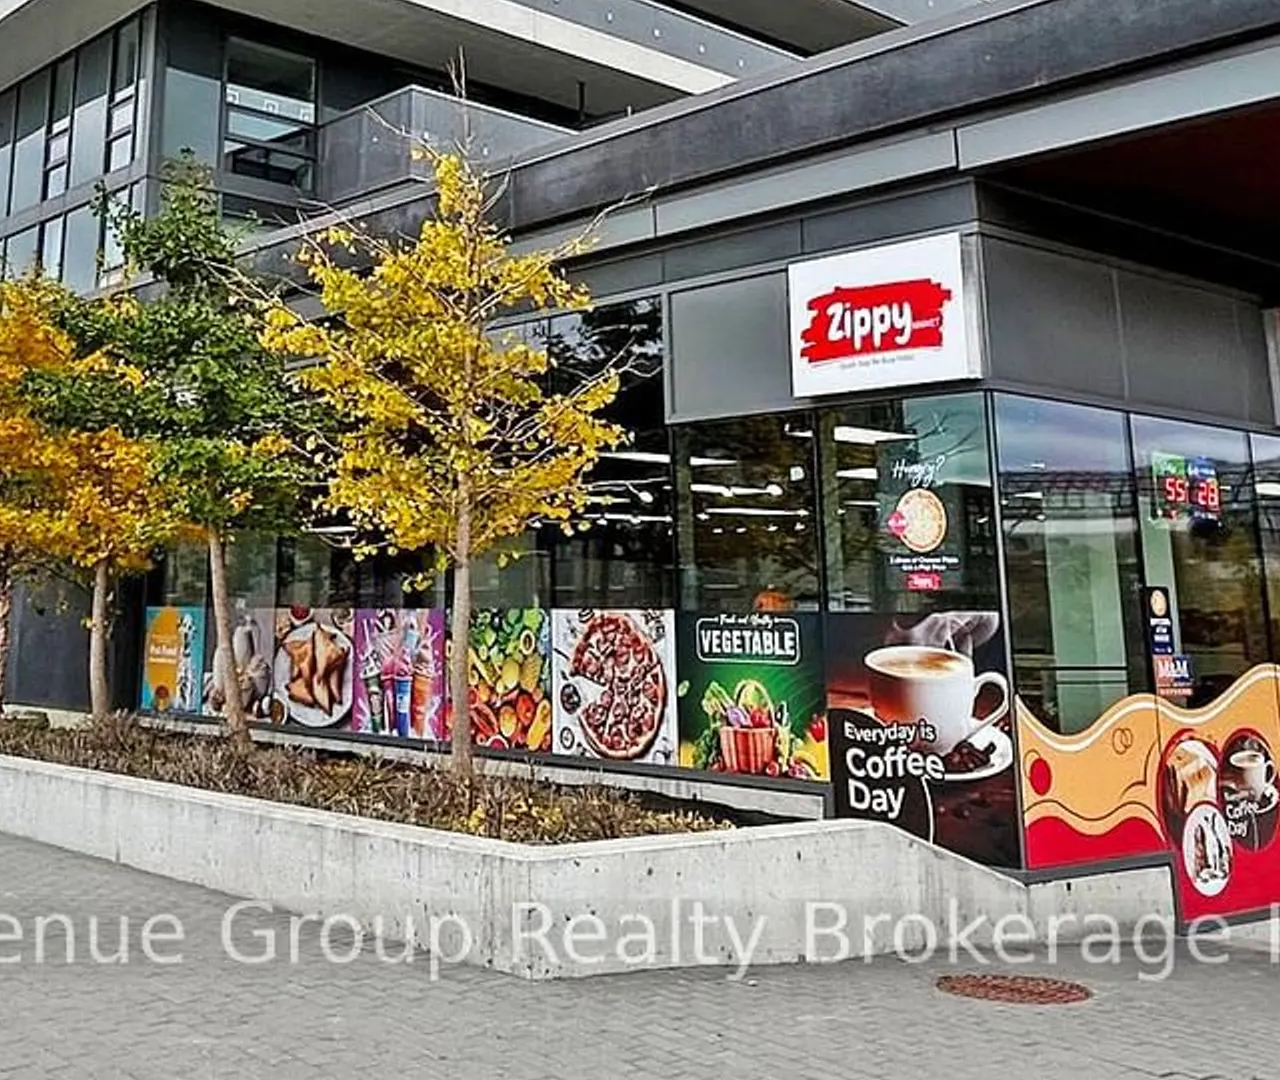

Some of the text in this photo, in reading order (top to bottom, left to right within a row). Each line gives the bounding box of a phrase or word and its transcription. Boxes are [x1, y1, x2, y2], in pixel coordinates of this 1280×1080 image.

[826, 301, 912, 351] Zippy
[892, 455, 946, 487] Hungry?
[700, 629, 795, 656] VEGETABLE
[844, 720, 935, 746] Everyday is
[846, 746, 945, 779] Coffee
[848, 778, 906, 819] Day
